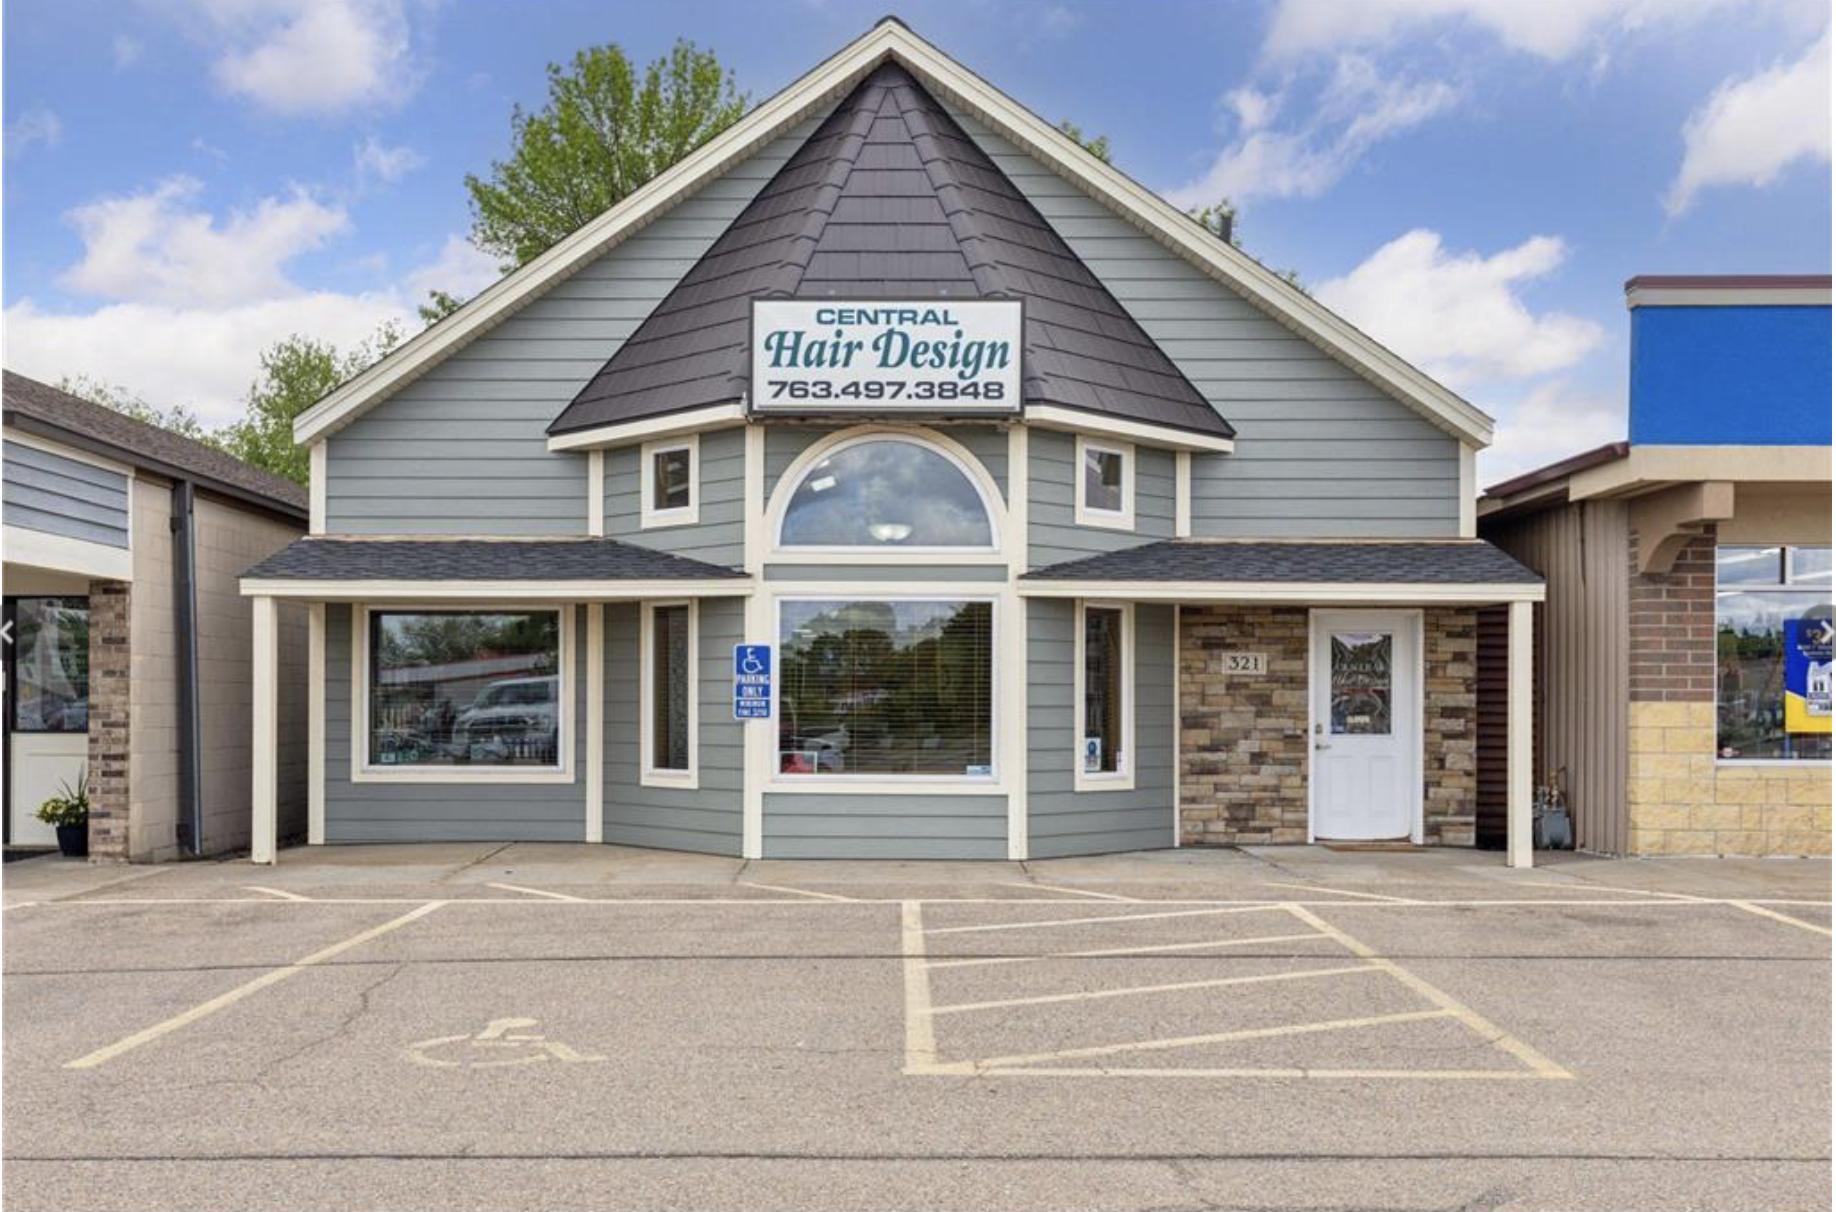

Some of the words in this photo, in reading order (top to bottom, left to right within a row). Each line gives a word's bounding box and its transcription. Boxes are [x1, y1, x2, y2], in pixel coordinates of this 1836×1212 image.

[816, 309, 959, 325] CENTRAL
[764, 329, 863, 368] Hair
[872, 327, 1011, 380] Design
[768, 381, 1005, 400] 763.497.3848
[1229, 656, 1259, 670] 321
[736, 674, 770, 685] PARKING
[742, 686, 763, 697] ONLY
